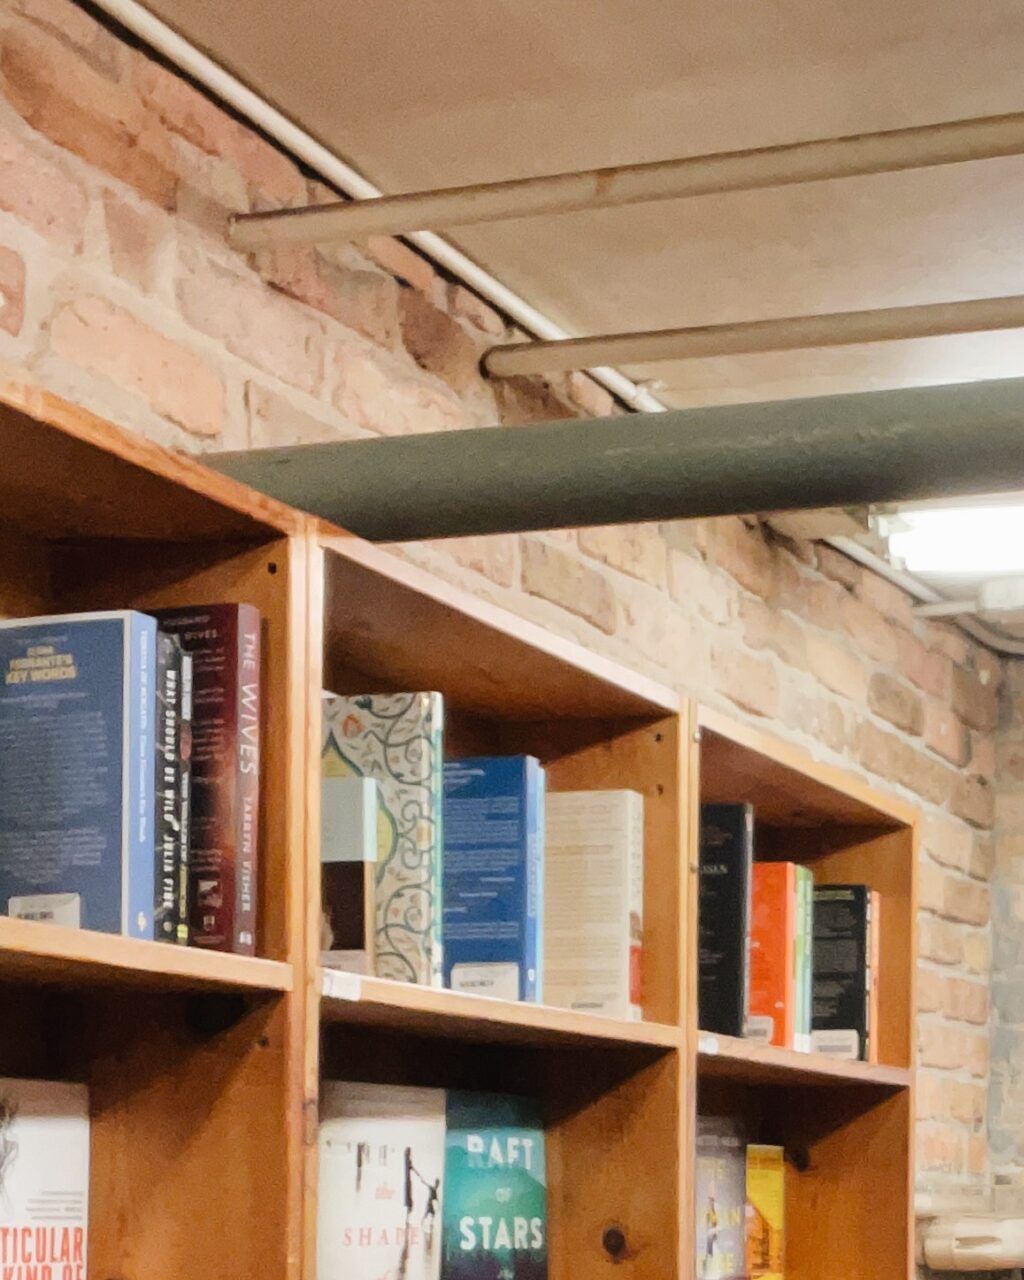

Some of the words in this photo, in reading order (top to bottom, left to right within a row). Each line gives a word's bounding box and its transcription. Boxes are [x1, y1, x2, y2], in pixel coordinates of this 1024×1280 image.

[244, 633, 257, 670] THE
[30, 665, 77, 682] WORDS
[165, 669, 177, 704] WHAT
[164, 710, 176, 761] SHOULD
[239, 683, 260, 776] WIVES
[164, 766, 175, 783] BE
[164, 789, 180, 831] WILD
[163, 834, 175, 873] JULIA
[162, 877, 174, 909] FINE
[467, 1134, 534, 1169] RAFT
[343, 1226, 421, 1246] SHAPE
[459, 1216, 543, 1251] STARS
